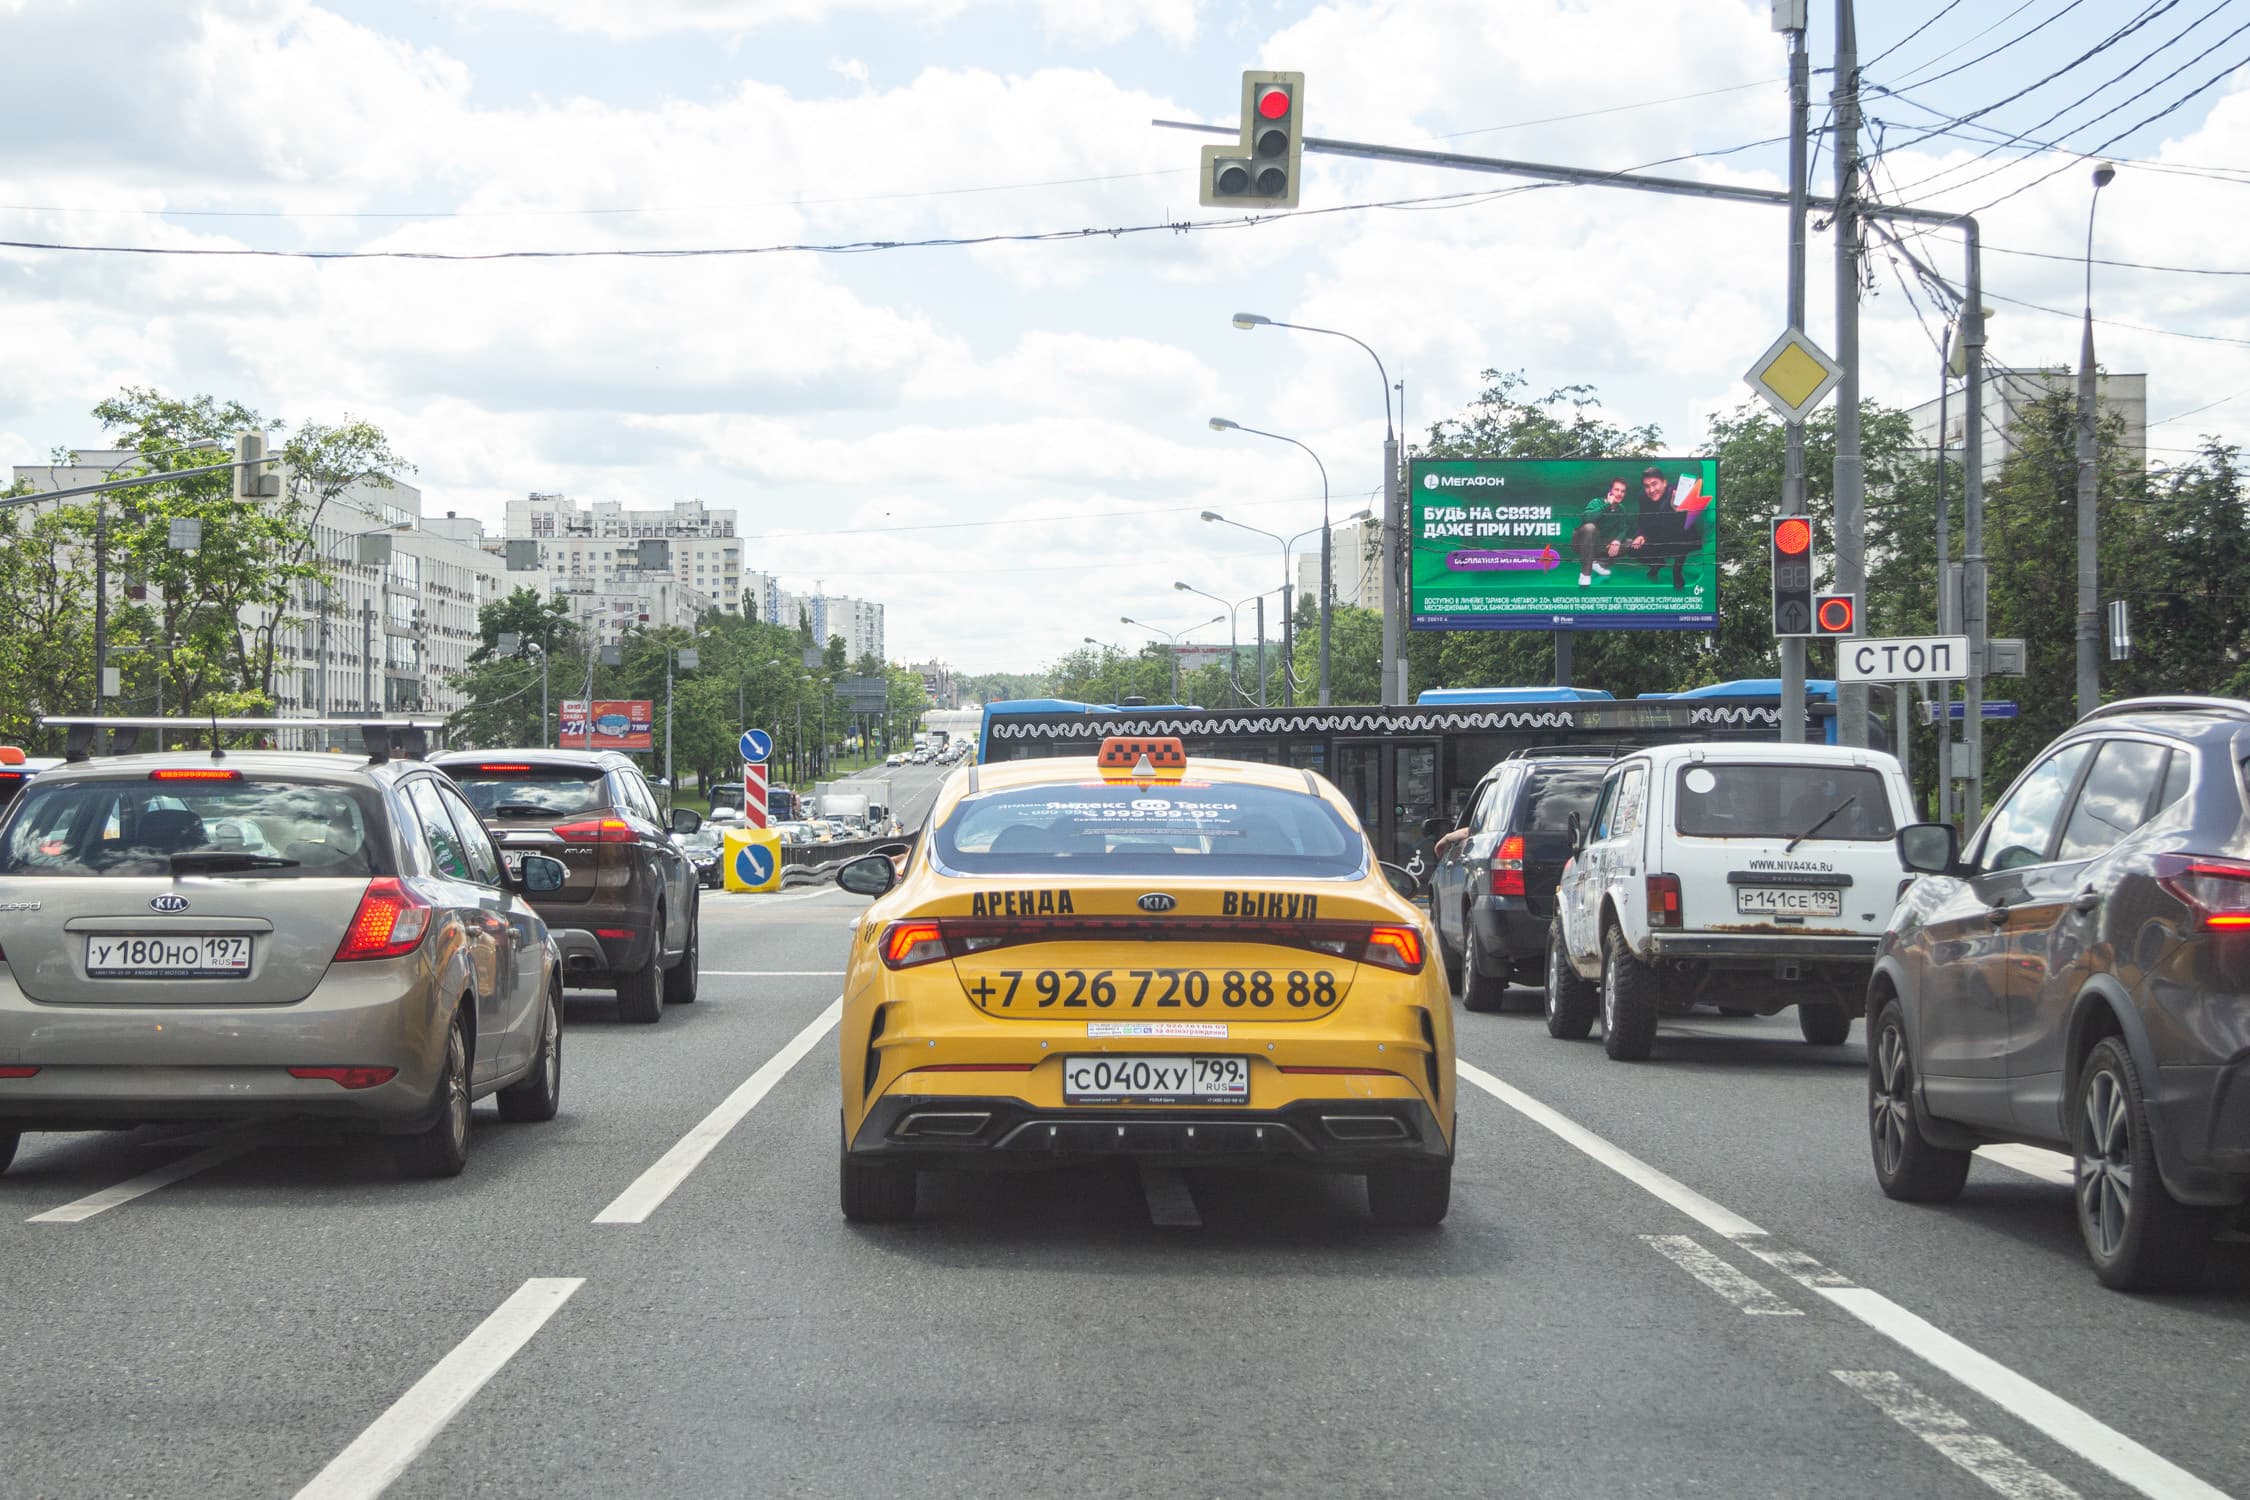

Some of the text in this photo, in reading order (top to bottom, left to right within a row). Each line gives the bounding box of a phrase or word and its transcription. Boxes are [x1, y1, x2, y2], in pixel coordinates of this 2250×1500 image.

[1424, 506, 1552, 522] БУДЬ НА СВЯЗИ
[1424, 523, 1561, 538] ДАЖЕ ПРИ НУЛЕ!
[1694, 585, 1704, 595] 6+
[1855, 644, 1950, 675] СТОП
[1174, 801, 1238, 810] Такси
[156, 898, 183, 909] KIA
[972, 889, 1075, 918] АРЕНДА
[1144, 897, 1171, 909] KIA
[1222, 890, 1318, 921] ВЫКУП
[205, 938, 243, 958] 197
[971, 970, 1337, 1008] +7 926 720 88 88
[1195, 1060, 1239, 1082] 799
[1206, 1082, 1228, 1091] RUS
